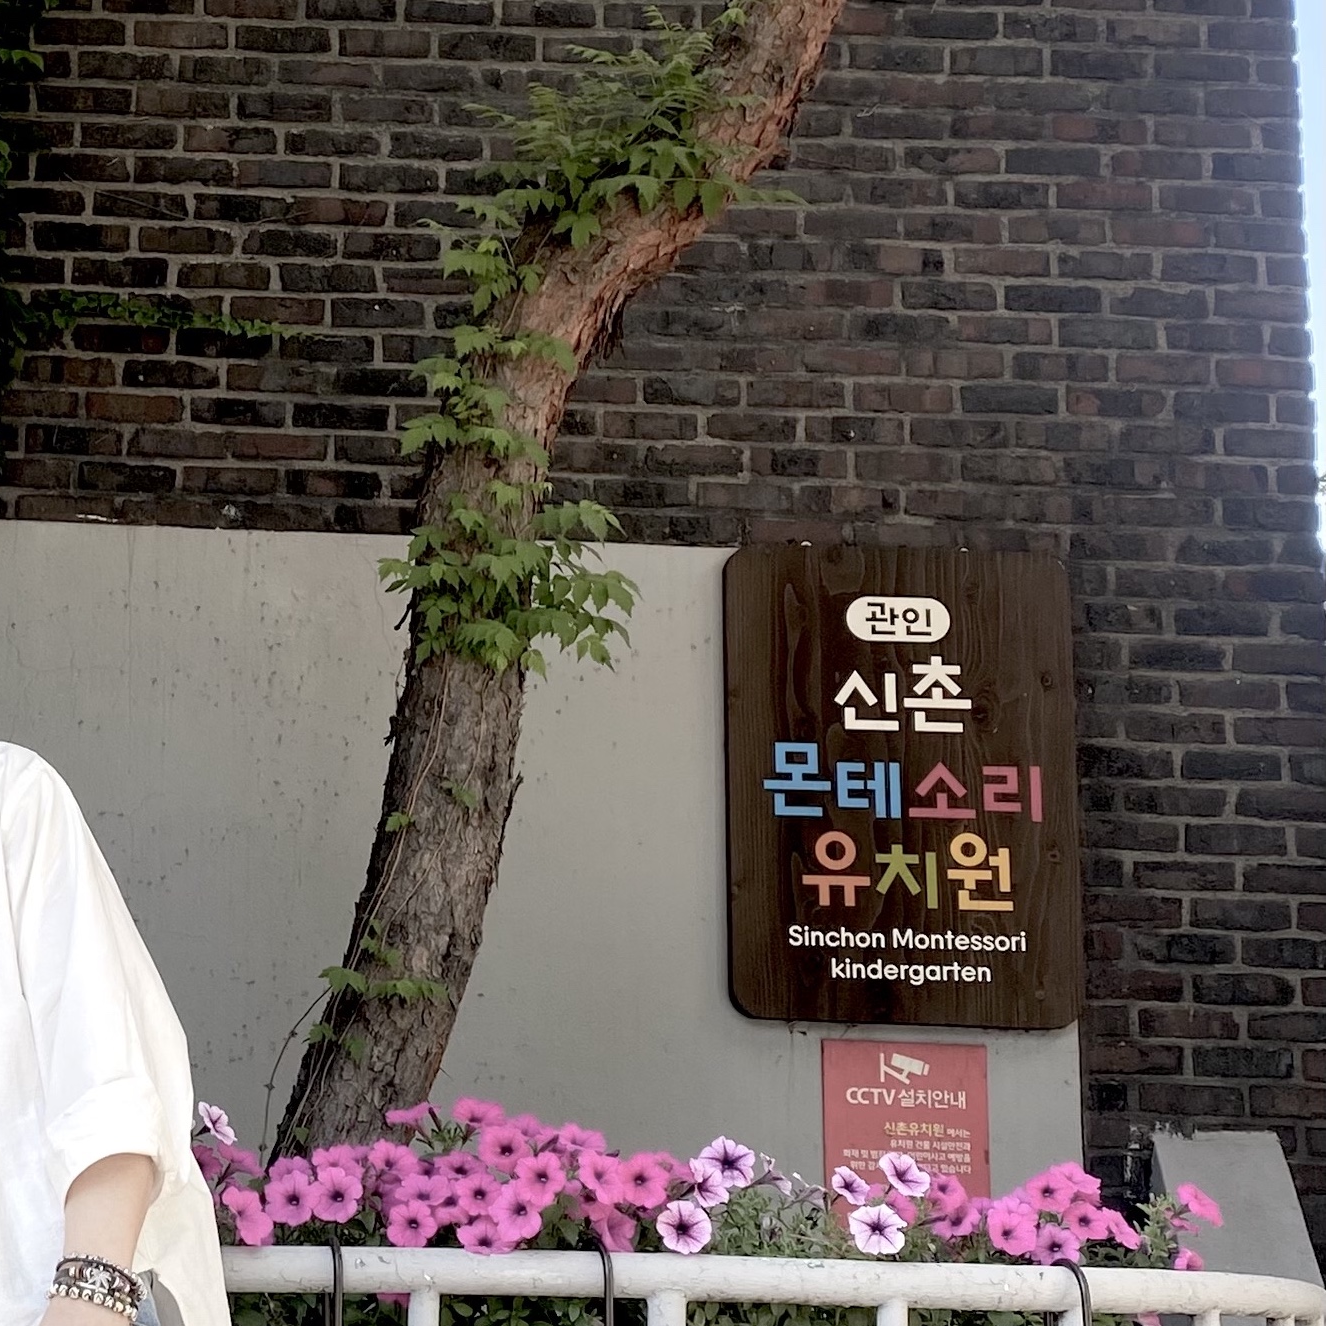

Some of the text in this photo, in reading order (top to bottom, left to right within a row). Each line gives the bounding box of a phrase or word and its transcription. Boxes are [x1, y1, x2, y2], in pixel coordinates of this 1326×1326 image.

[865, 602, 932, 636] 관인
[834, 655, 973, 733] 신촌
[763, 741, 1043, 822] 몬테소리
[802, 830, 1014, 912] 유치원
[788, 924, 1028, 953] Sinchon Montessori
[830, 957, 992, 985] kindergarten
[845, 1087, 967, 1110] CCTV 설치안내
[884, 1121, 945, 1137] 신촌유치원
